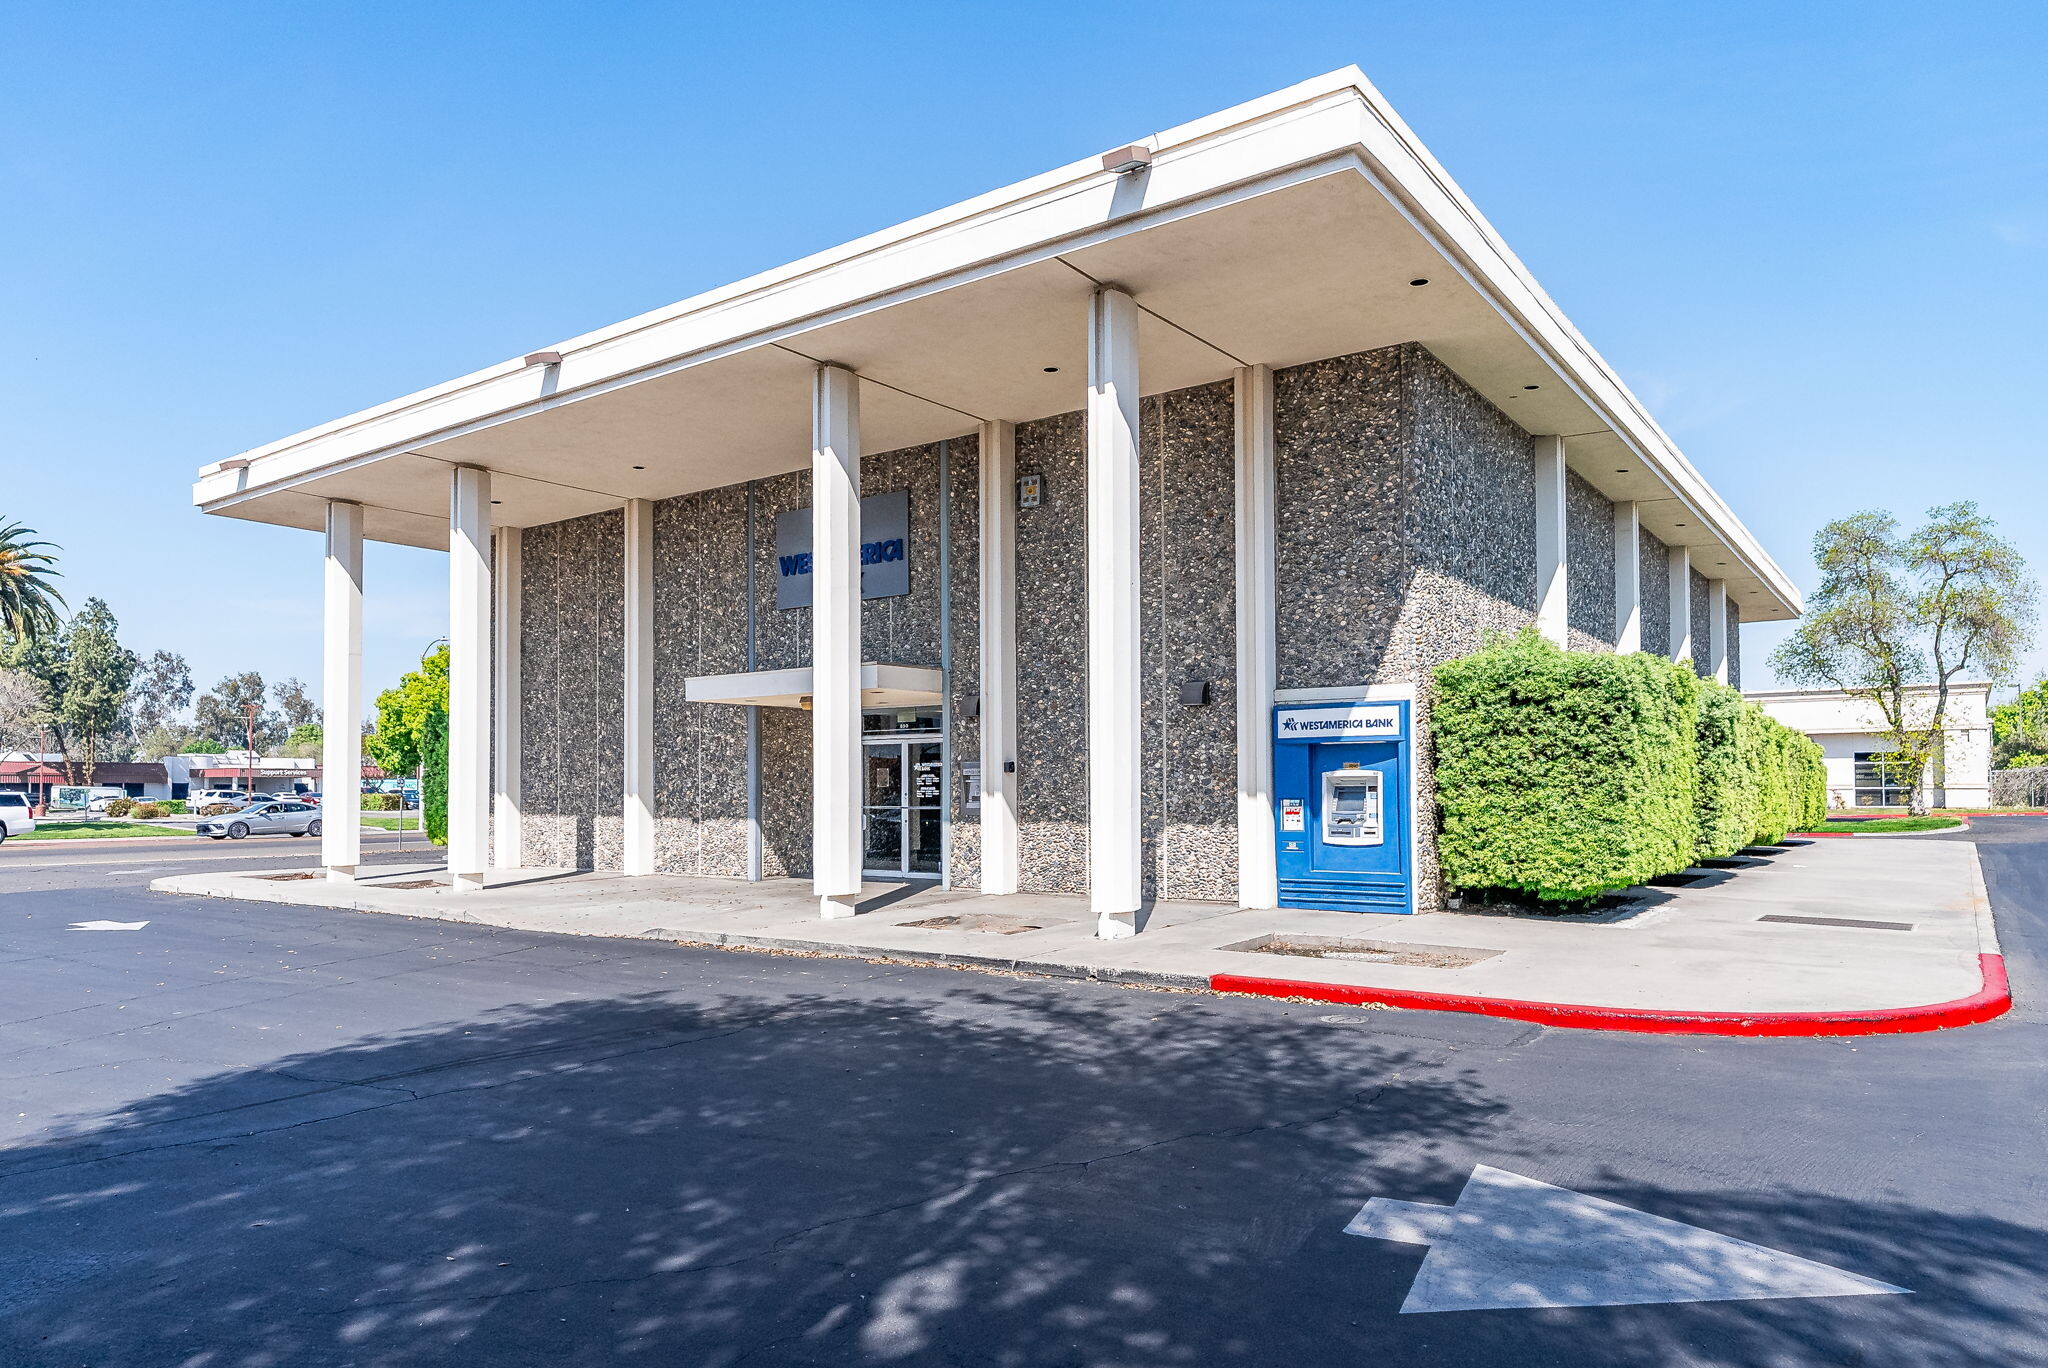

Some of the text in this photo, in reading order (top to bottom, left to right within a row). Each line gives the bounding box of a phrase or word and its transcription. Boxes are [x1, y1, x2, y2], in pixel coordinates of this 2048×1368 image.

[1300, 718, 1394, 731] WESTAMERICA BANK
[261, 769, 283, 777] Support
